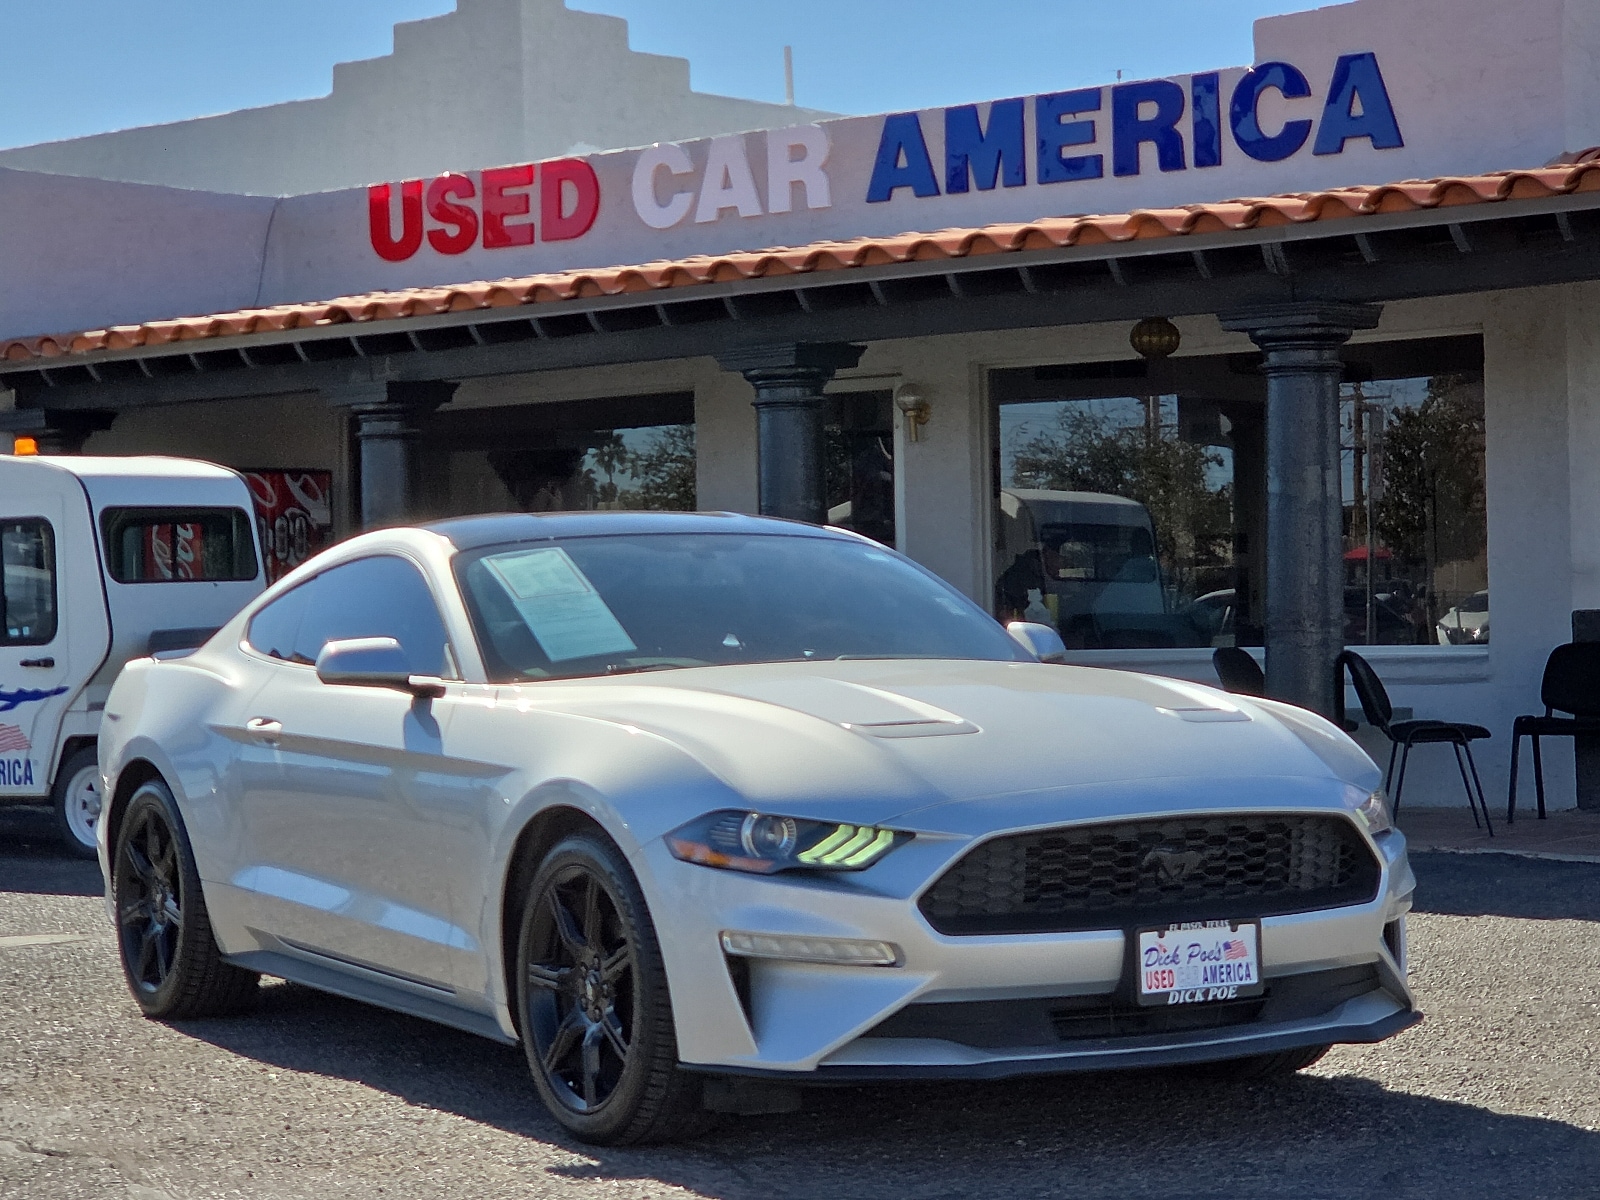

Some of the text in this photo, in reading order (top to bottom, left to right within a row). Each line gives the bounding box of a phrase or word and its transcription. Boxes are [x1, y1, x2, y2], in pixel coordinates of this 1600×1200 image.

[367, 51, 1404, 263] USED CAR AMERICA
[1144, 941, 1221, 967] Dick Poe's
[1145, 968, 1175, 990] USED
[1202, 962, 1252, 984] AMERICA
[1167, 985, 1238, 1005] DICK POE
